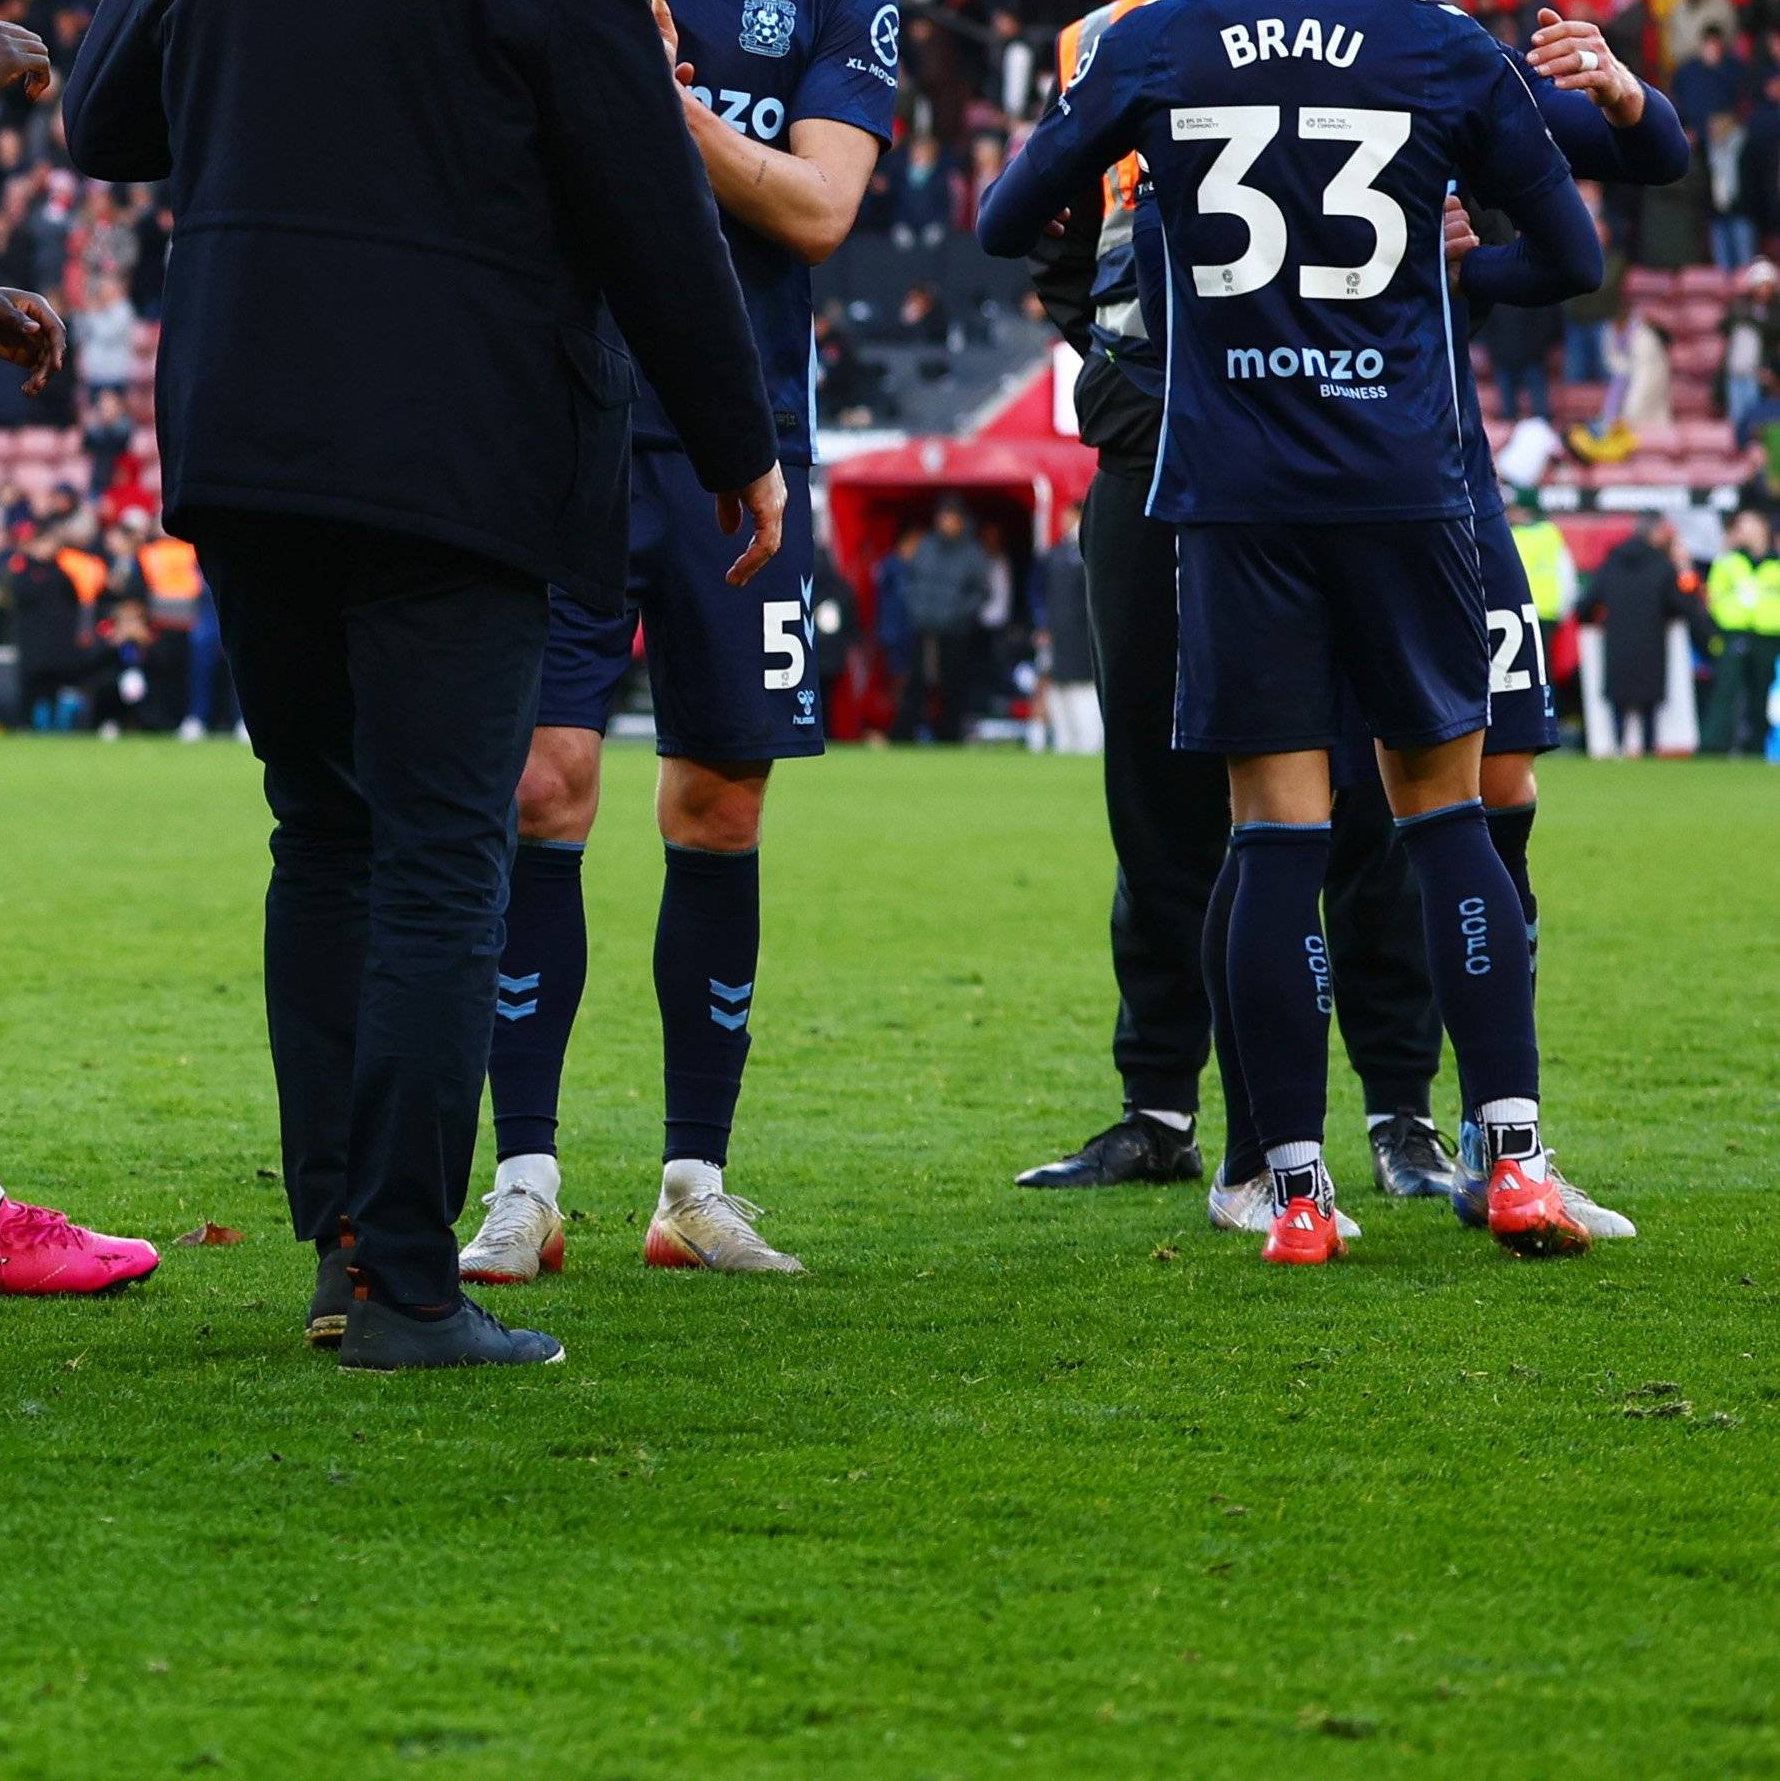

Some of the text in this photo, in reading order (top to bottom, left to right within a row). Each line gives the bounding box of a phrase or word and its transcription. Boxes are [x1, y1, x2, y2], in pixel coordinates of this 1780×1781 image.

[846, 57, 867, 71] XL
[1220, 19, 1364, 68] BRAU
[1170, 105, 1411, 300] 33
[1227, 347, 1384, 379] monzo
[763, 601, 805, 690] 5
[1486, 603, 1547, 693] 21
[1459, 897, 1491, 975] CCFC
